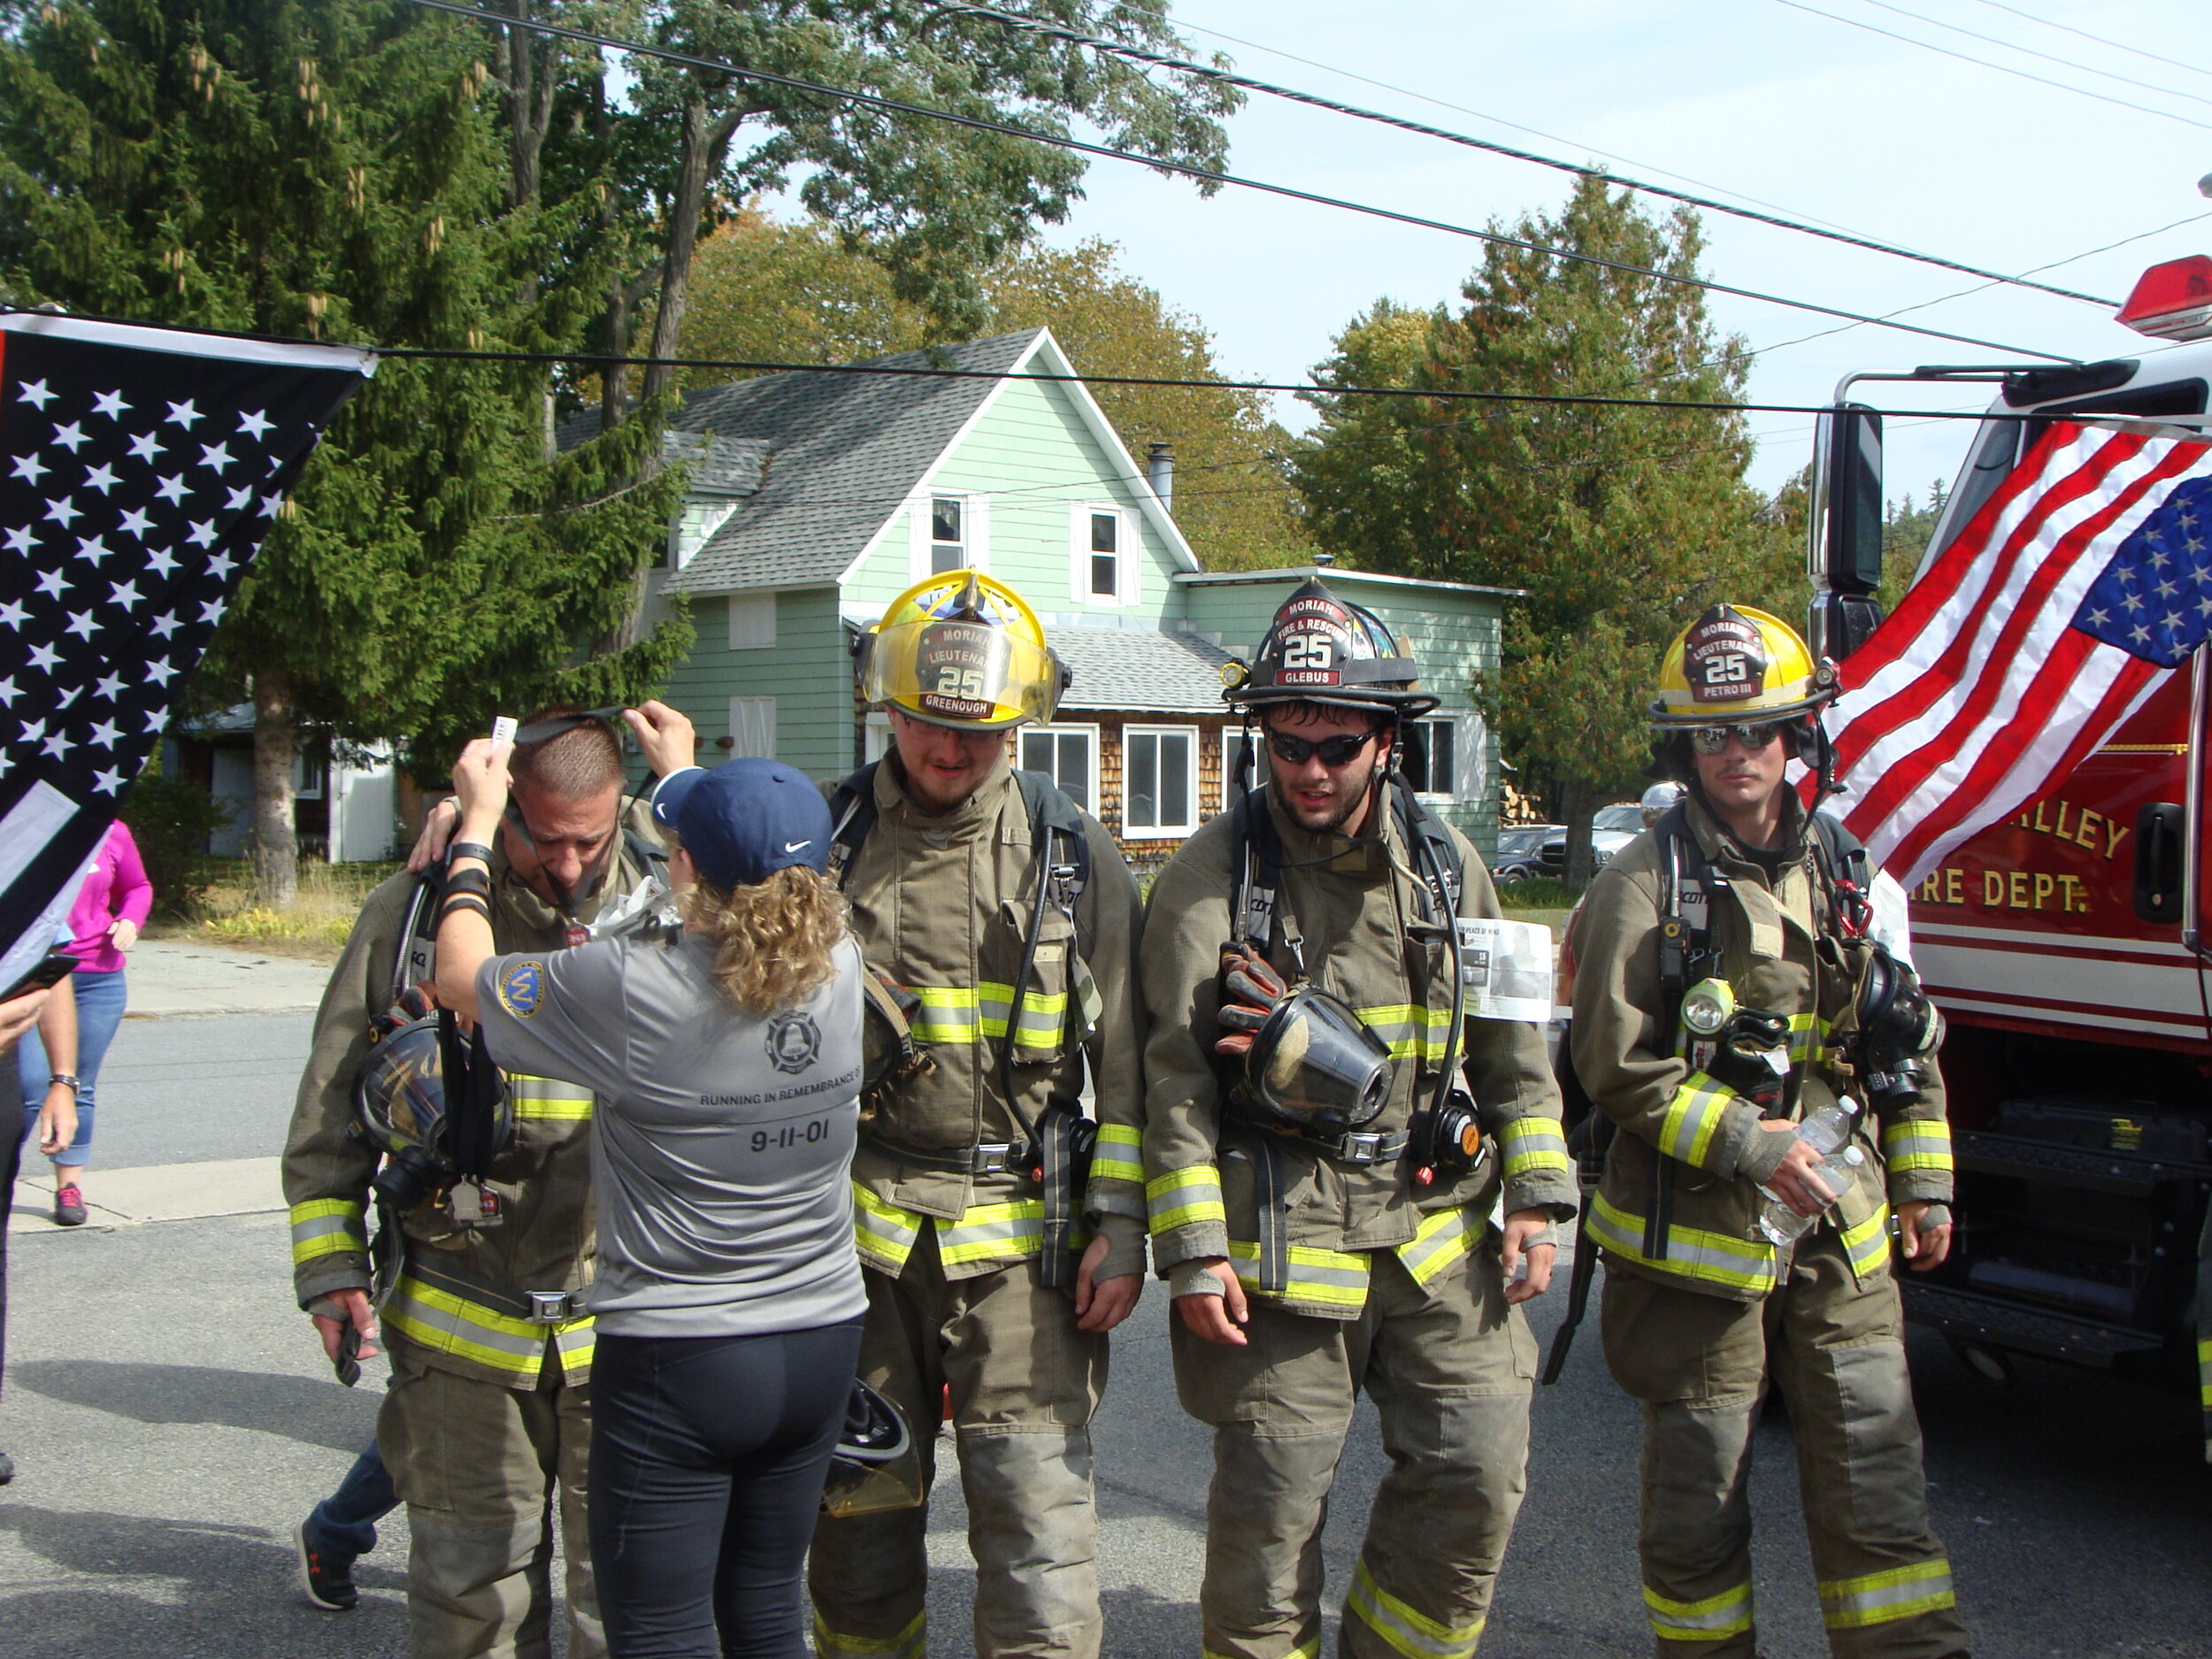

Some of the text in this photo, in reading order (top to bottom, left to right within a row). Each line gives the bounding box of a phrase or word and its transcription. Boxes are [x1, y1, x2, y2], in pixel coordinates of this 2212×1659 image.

[1289, 599, 1334, 616] MORIAH
[1278, 623, 1296, 641] FIRE
[1297, 620, 1305, 631] &
[1284, 634, 1333, 669] 25
[938, 665, 985, 701] 25
[1285, 672, 1330, 683] GLEBUS
[1704, 654, 1747, 683] 25
[926, 695, 987, 713] GREENOUGH
[1704, 683, 1752, 697] PETRO III
[2009, 799, 2131, 860] LLEY
[1984, 870, 2087, 912] DEPT.
[700, 1094, 762, 1106] RUNNING
[764, 1092, 777, 1103] IN
[779, 1071, 855, 1101] REMEMBRANCE
[751, 1118, 830, 1152] 9-11-01
